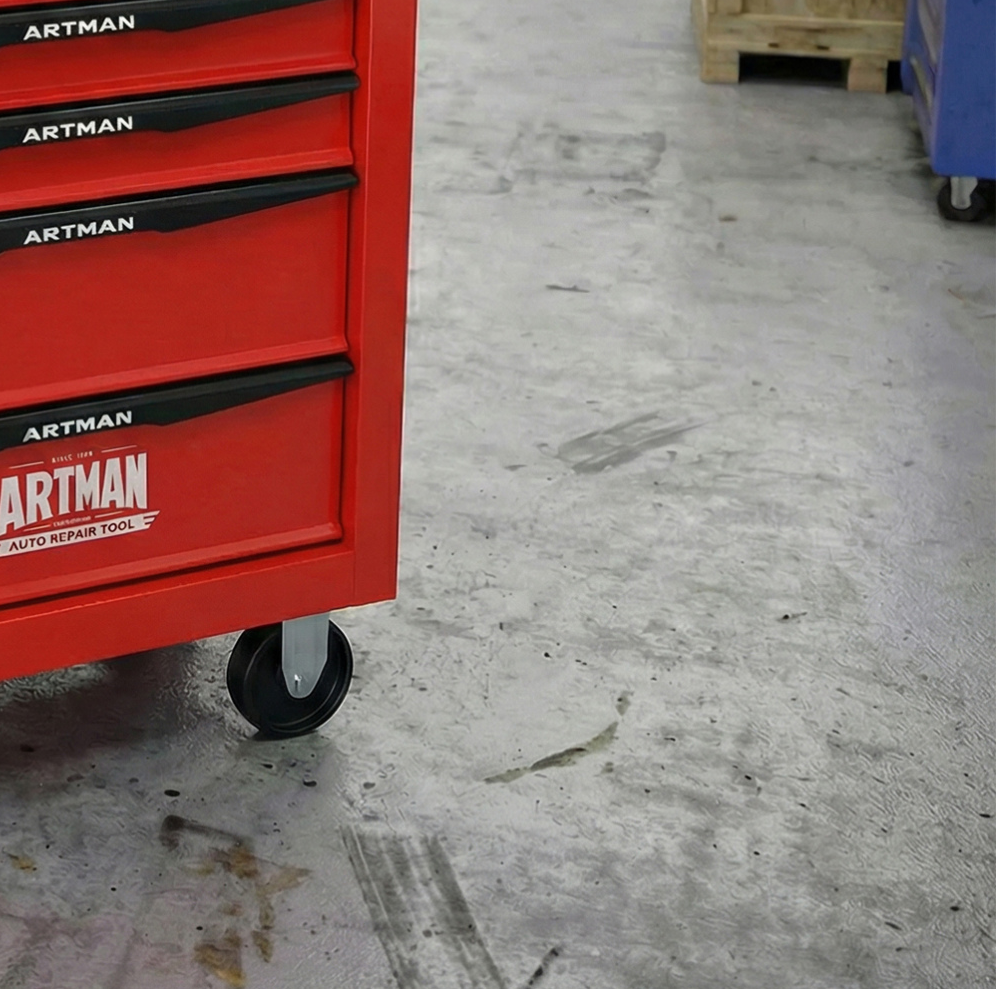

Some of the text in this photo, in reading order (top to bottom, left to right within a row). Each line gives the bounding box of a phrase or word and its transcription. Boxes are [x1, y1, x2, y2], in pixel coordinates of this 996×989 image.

[23, 14, 135, 41] ARTMAN
[22, 115, 133, 143] ARTMAN
[23, 216, 134, 245] ARTMAN
[22, 410, 132, 442] ARTMAN
[8, 536, 46, 552] AUTO
[50, 526, 97, 544] REPAIR
[100, 519, 135, 534] TOOL
